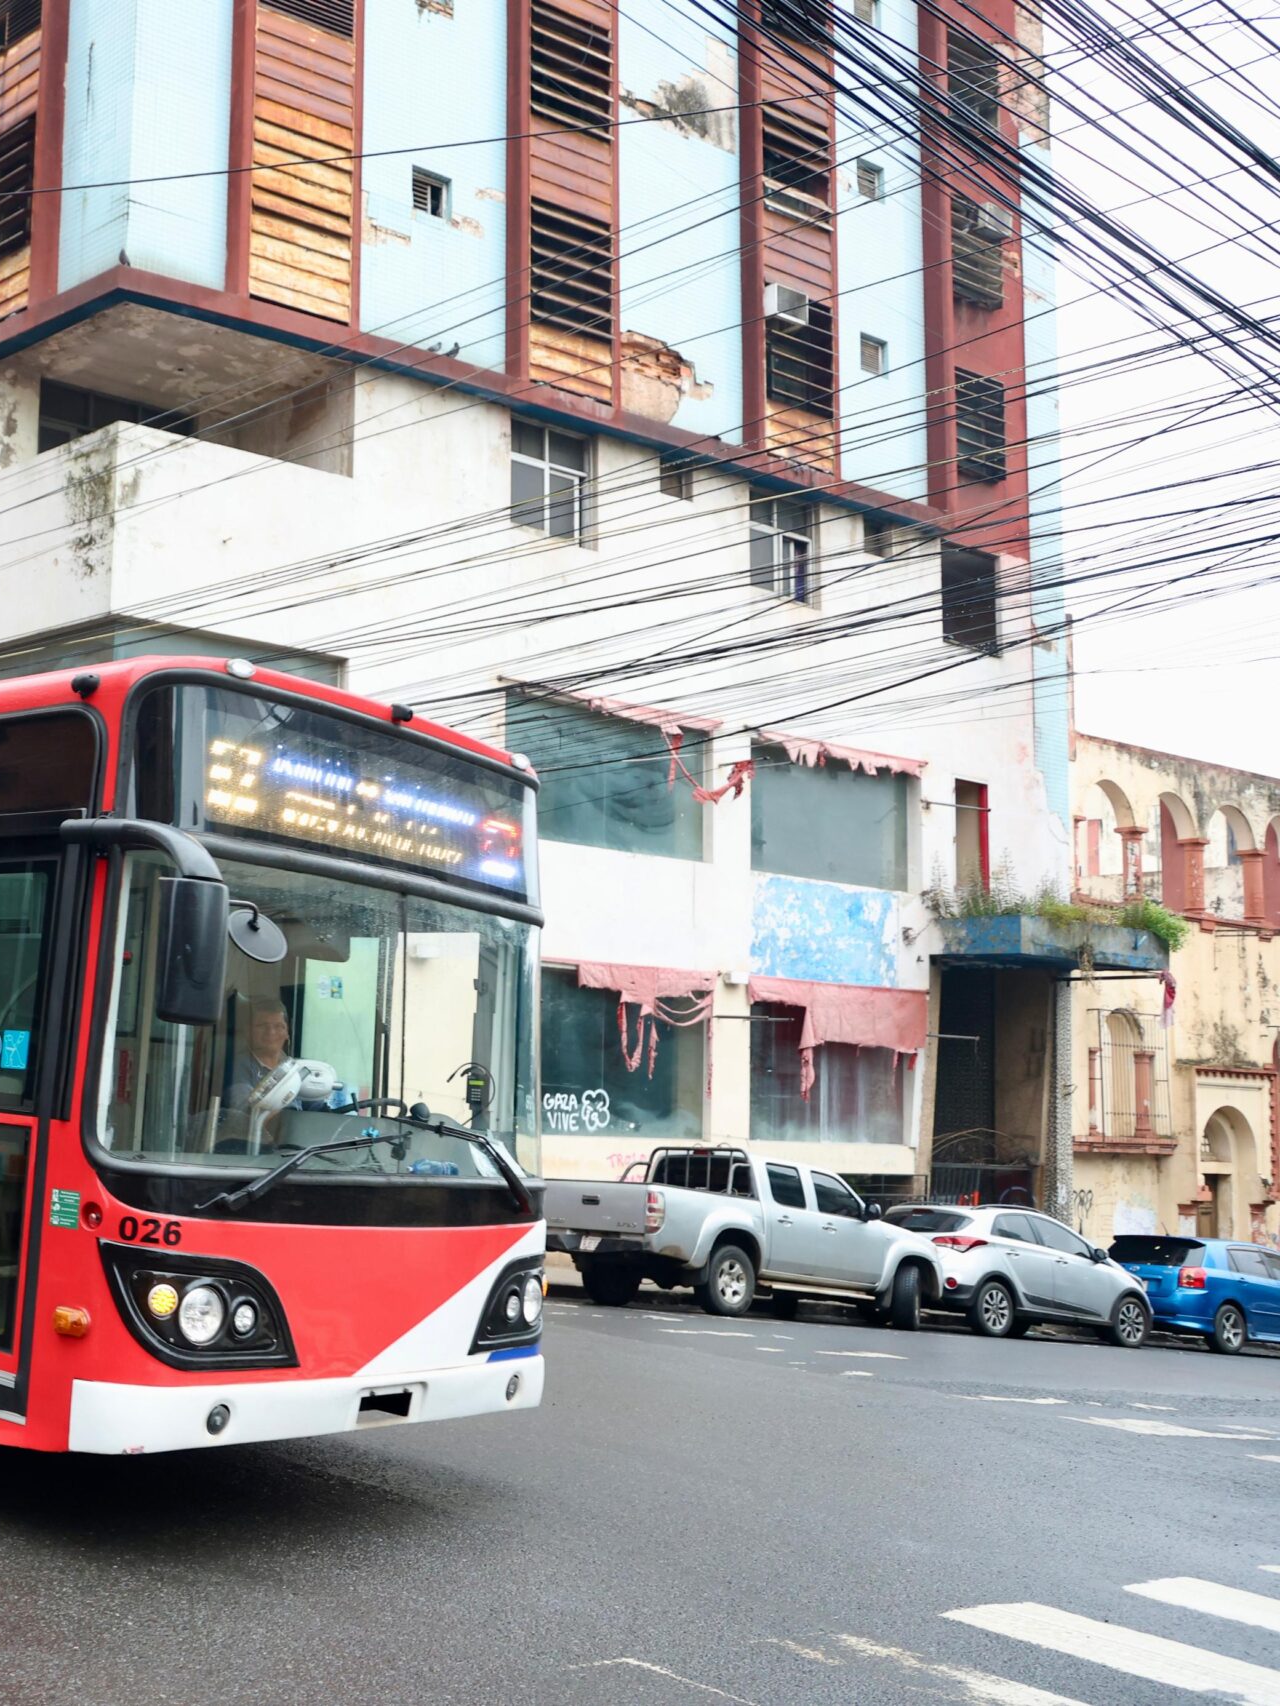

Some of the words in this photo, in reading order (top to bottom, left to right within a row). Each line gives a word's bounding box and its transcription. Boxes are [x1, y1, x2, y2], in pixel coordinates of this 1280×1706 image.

[543, 1093, 578, 1111] GAZA
[547, 1111, 579, 1132] VIVE
[118, 1216, 182, 1246] 026
